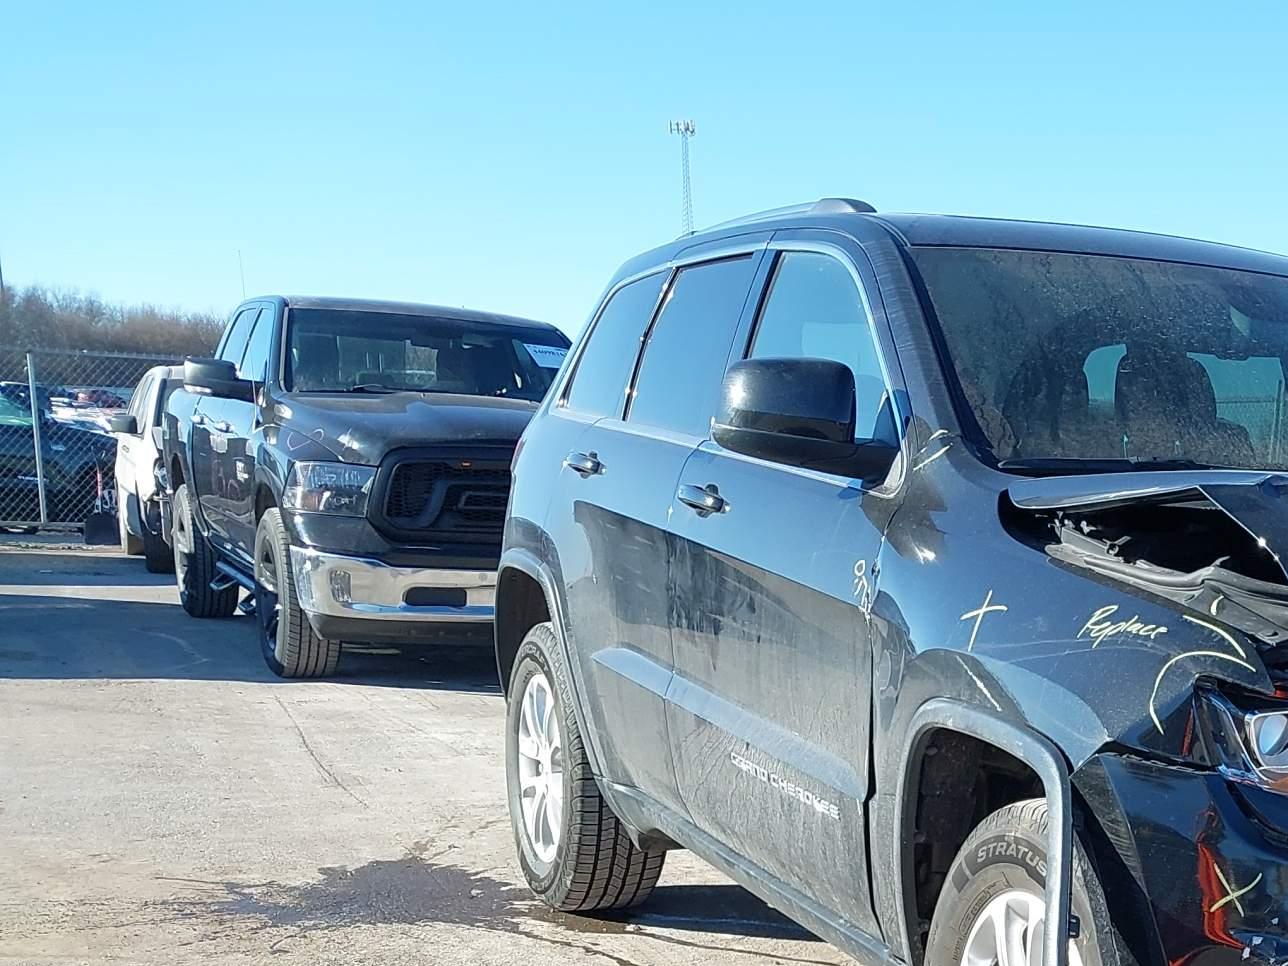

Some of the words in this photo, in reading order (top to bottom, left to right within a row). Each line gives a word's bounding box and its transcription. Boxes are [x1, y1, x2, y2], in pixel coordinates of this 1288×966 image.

[1076, 604, 1169, 649] Replace
[769, 773, 840, 820] CHEROKEE
[977, 841, 1048, 877] STRATUS
